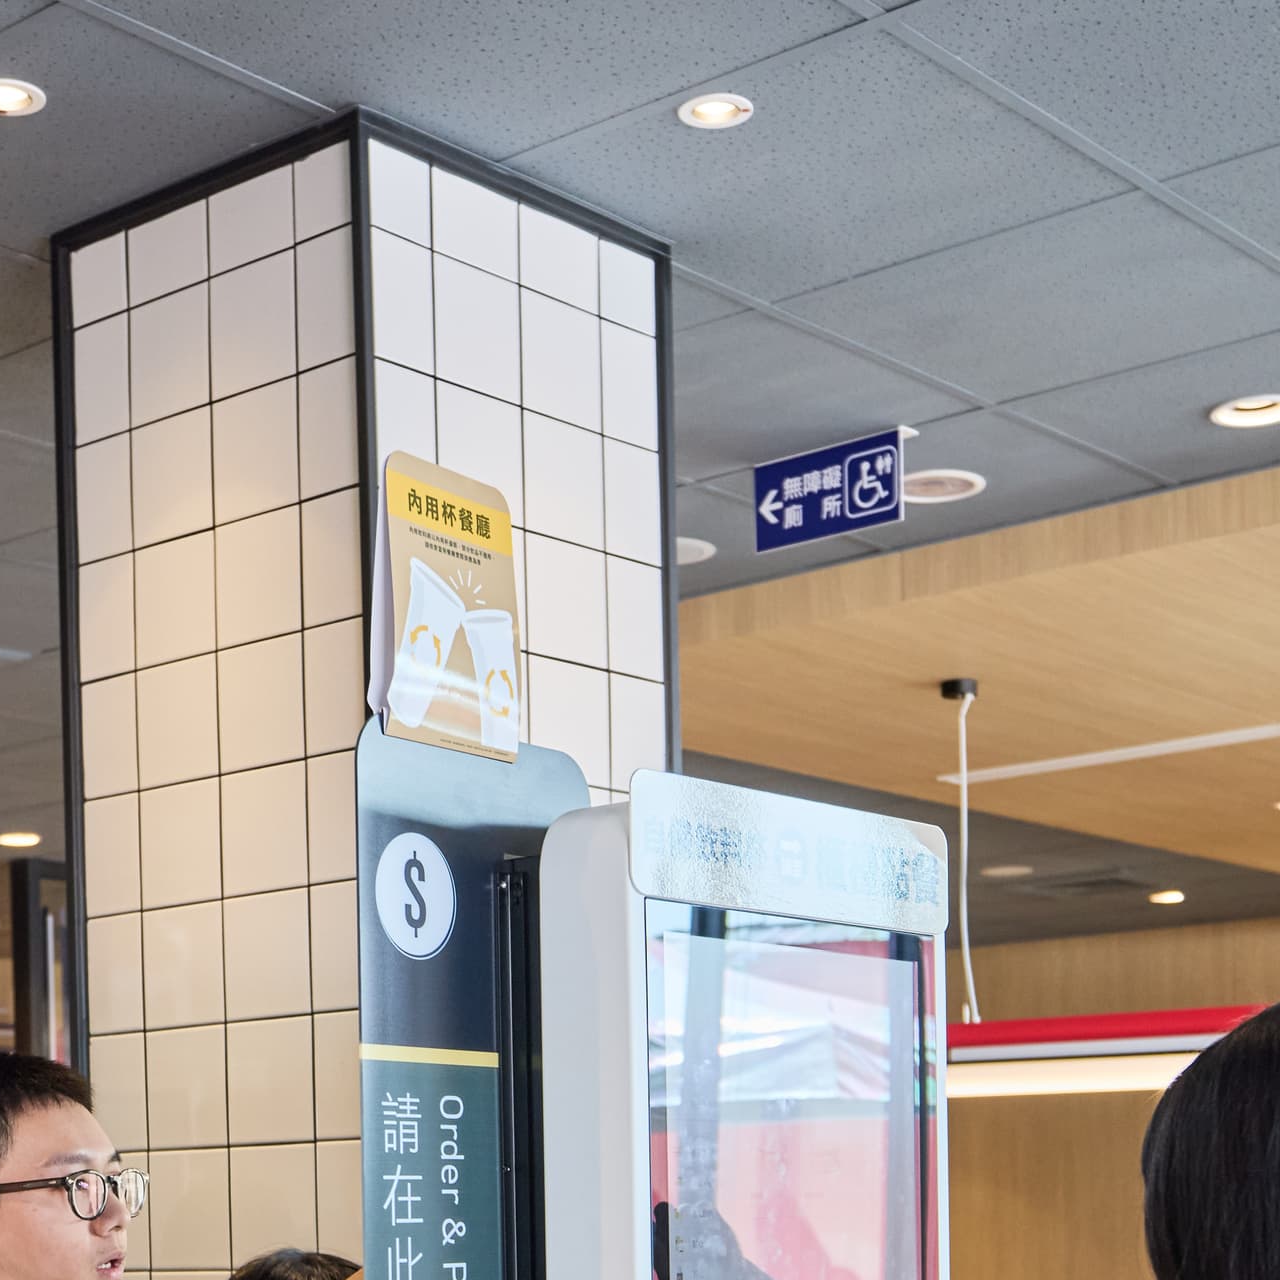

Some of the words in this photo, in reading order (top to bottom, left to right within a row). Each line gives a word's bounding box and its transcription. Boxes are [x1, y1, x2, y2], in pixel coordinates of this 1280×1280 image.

[782, 464, 843, 501] 無障礙
[407, 488, 491, 540] 內用杯餐廳
[782, 494, 843, 530] 廁所
[439, 1095, 465, 1205] Order
[441, 1218, 467, 1246] &
